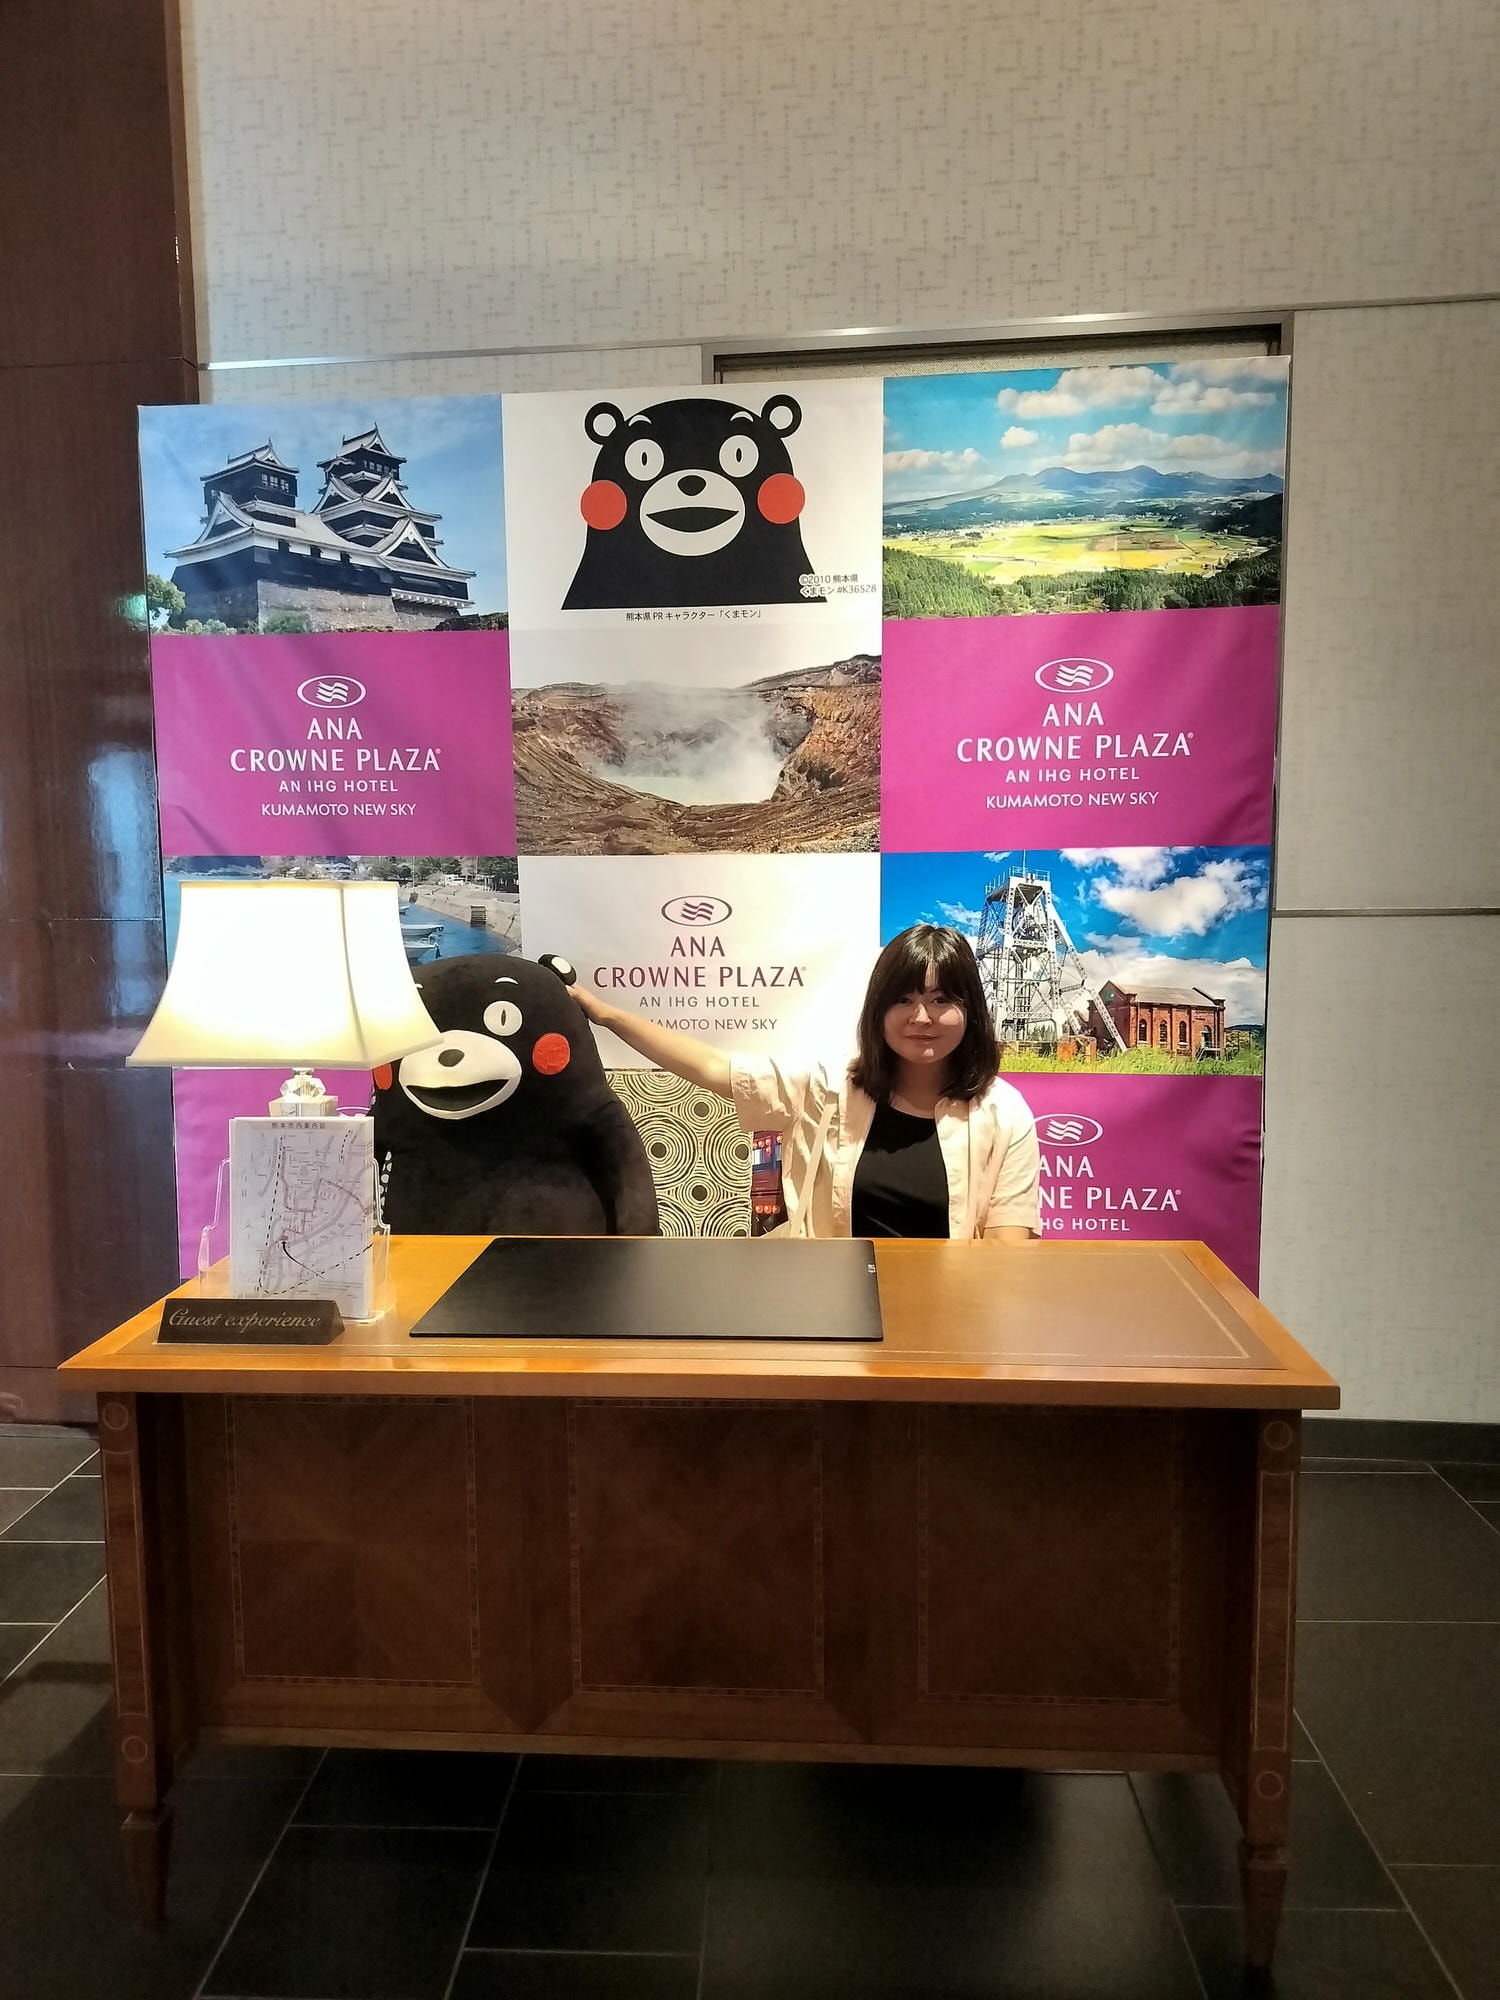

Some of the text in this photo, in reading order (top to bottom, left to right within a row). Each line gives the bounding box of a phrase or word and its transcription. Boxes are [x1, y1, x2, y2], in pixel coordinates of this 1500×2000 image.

[800, 586, 835, 596] くまモン
[626, 611, 651, 621] 熊本県
[653, 612, 664, 621] PR
[1041, 701, 1105, 727] ANA
[306, 717, 363, 741] ANA
[956, 735, 1082, 763] CROWNE
[230, 748, 345, 772] CROWNE
[1004, 767, 1140, 783] AN IHG HOTEL
[279, 780, 399, 792] AN IHG HOTEL
[985, 791, 1160, 809] KUMAMOTO NEW SKY
[261, 803, 417, 816] KUMAMOTO NEW SKY
[670, 935, 726, 957] ANA
[593, 966, 707, 988] CROWNE
[639, 996, 760, 1008] AN IHG HOTEL
[650, 1018, 778, 1031] AMOTO NEW SKY
[1039, 1154, 1095, 1178] ANA
[1071, 1217, 1131, 1232] HOTEL
[168, 1308, 321, 1334] Guest experience
